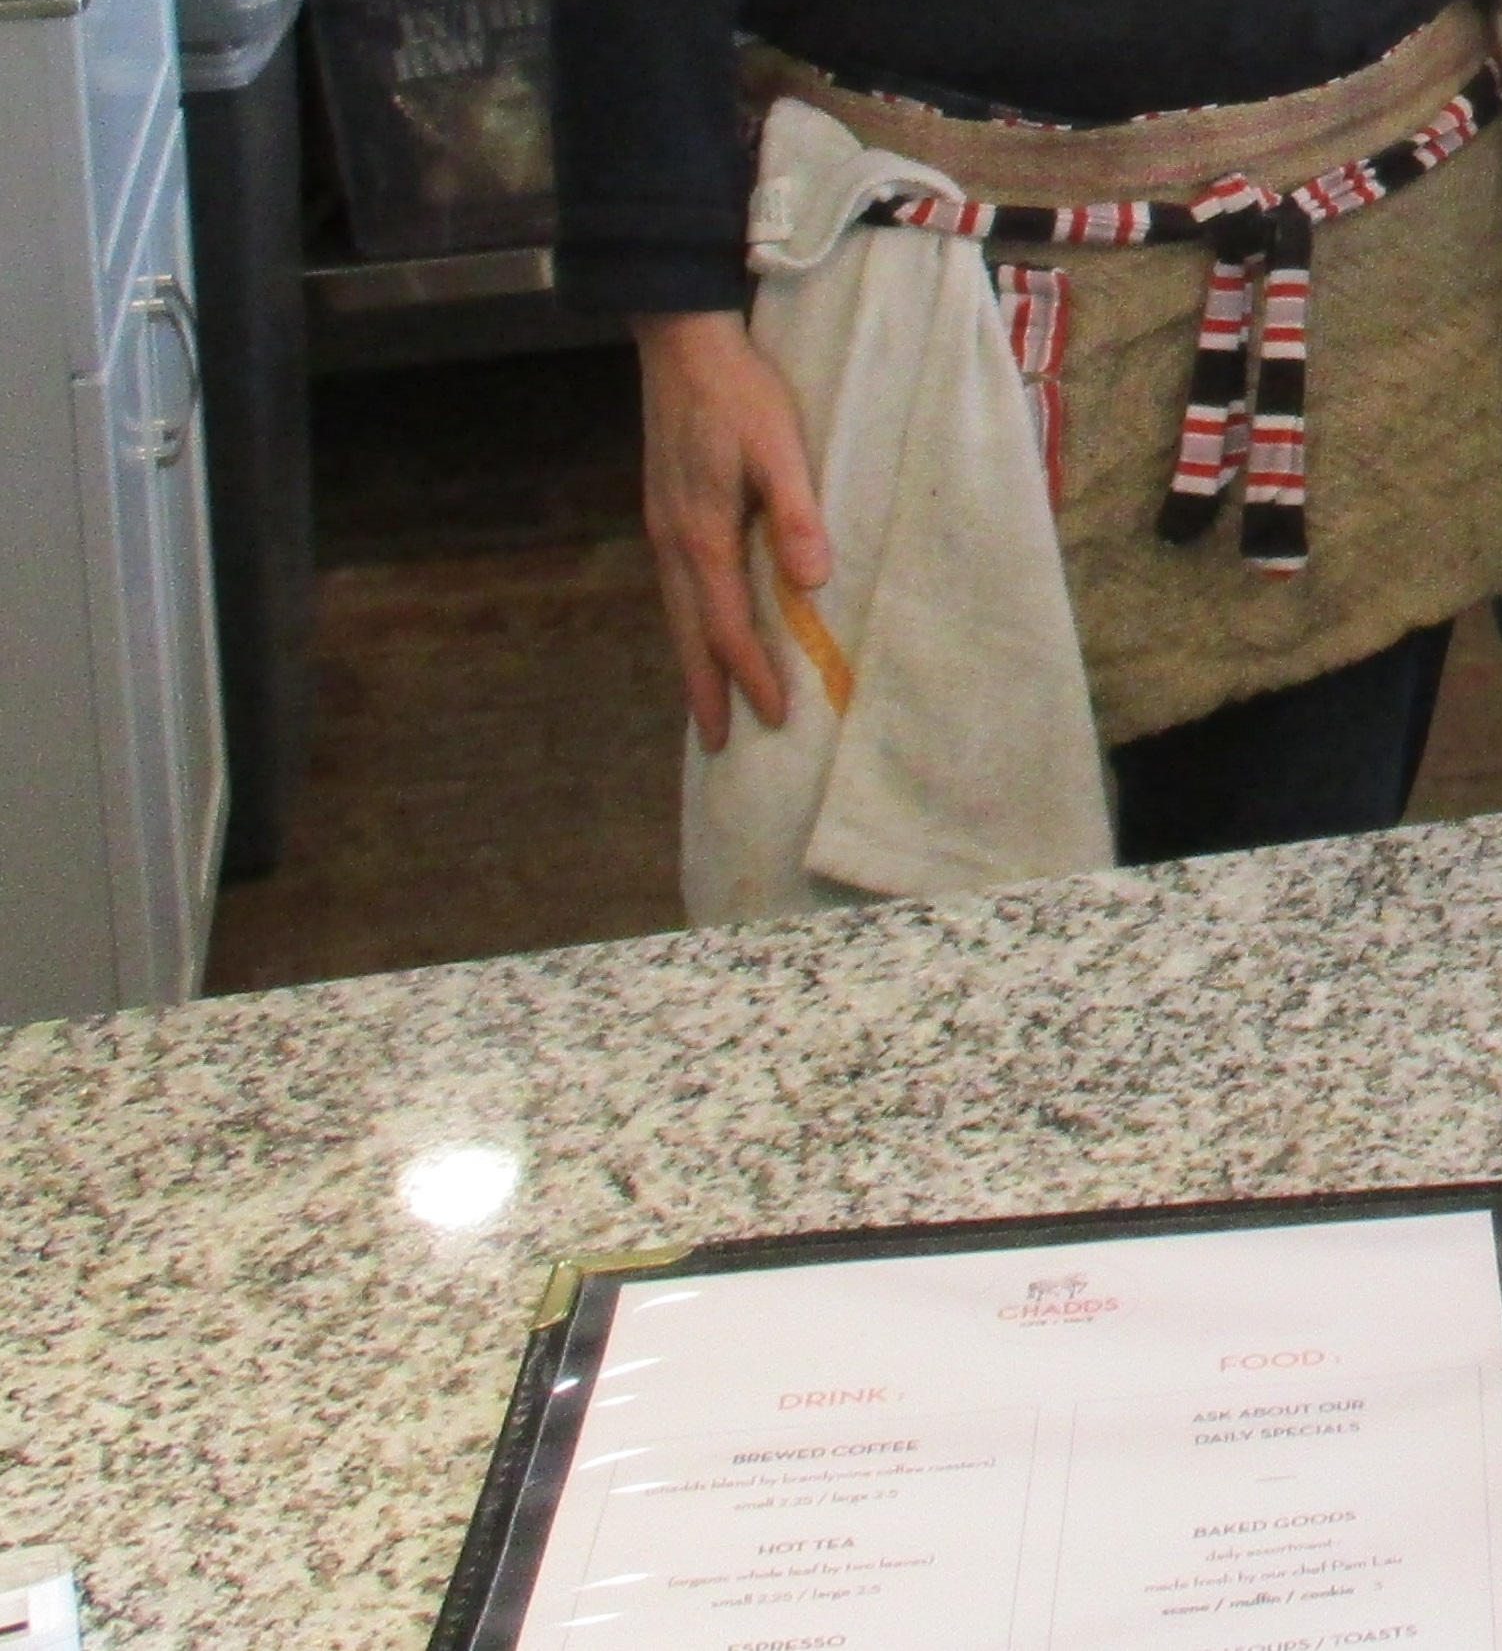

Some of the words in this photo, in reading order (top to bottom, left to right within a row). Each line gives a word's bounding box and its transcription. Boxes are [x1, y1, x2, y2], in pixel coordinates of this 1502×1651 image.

[997, 1297, 1120, 1321] CHADDS
[1238, 1401, 1315, 1423] ABOUT
[1258, 1420, 1361, 1440] SPECIALS
[731, 1447, 828, 1467] BREWED
[830, 1438, 920, 1458] COFFEE
[1193, 1519, 1268, 1539] BAKED
[1273, 1509, 1358, 1530] GOODS
[757, 1541, 804, 1557] HOT
[810, 1536, 856, 1552] TEA
[1333, 1624, 1419, 1646] TOASTS
